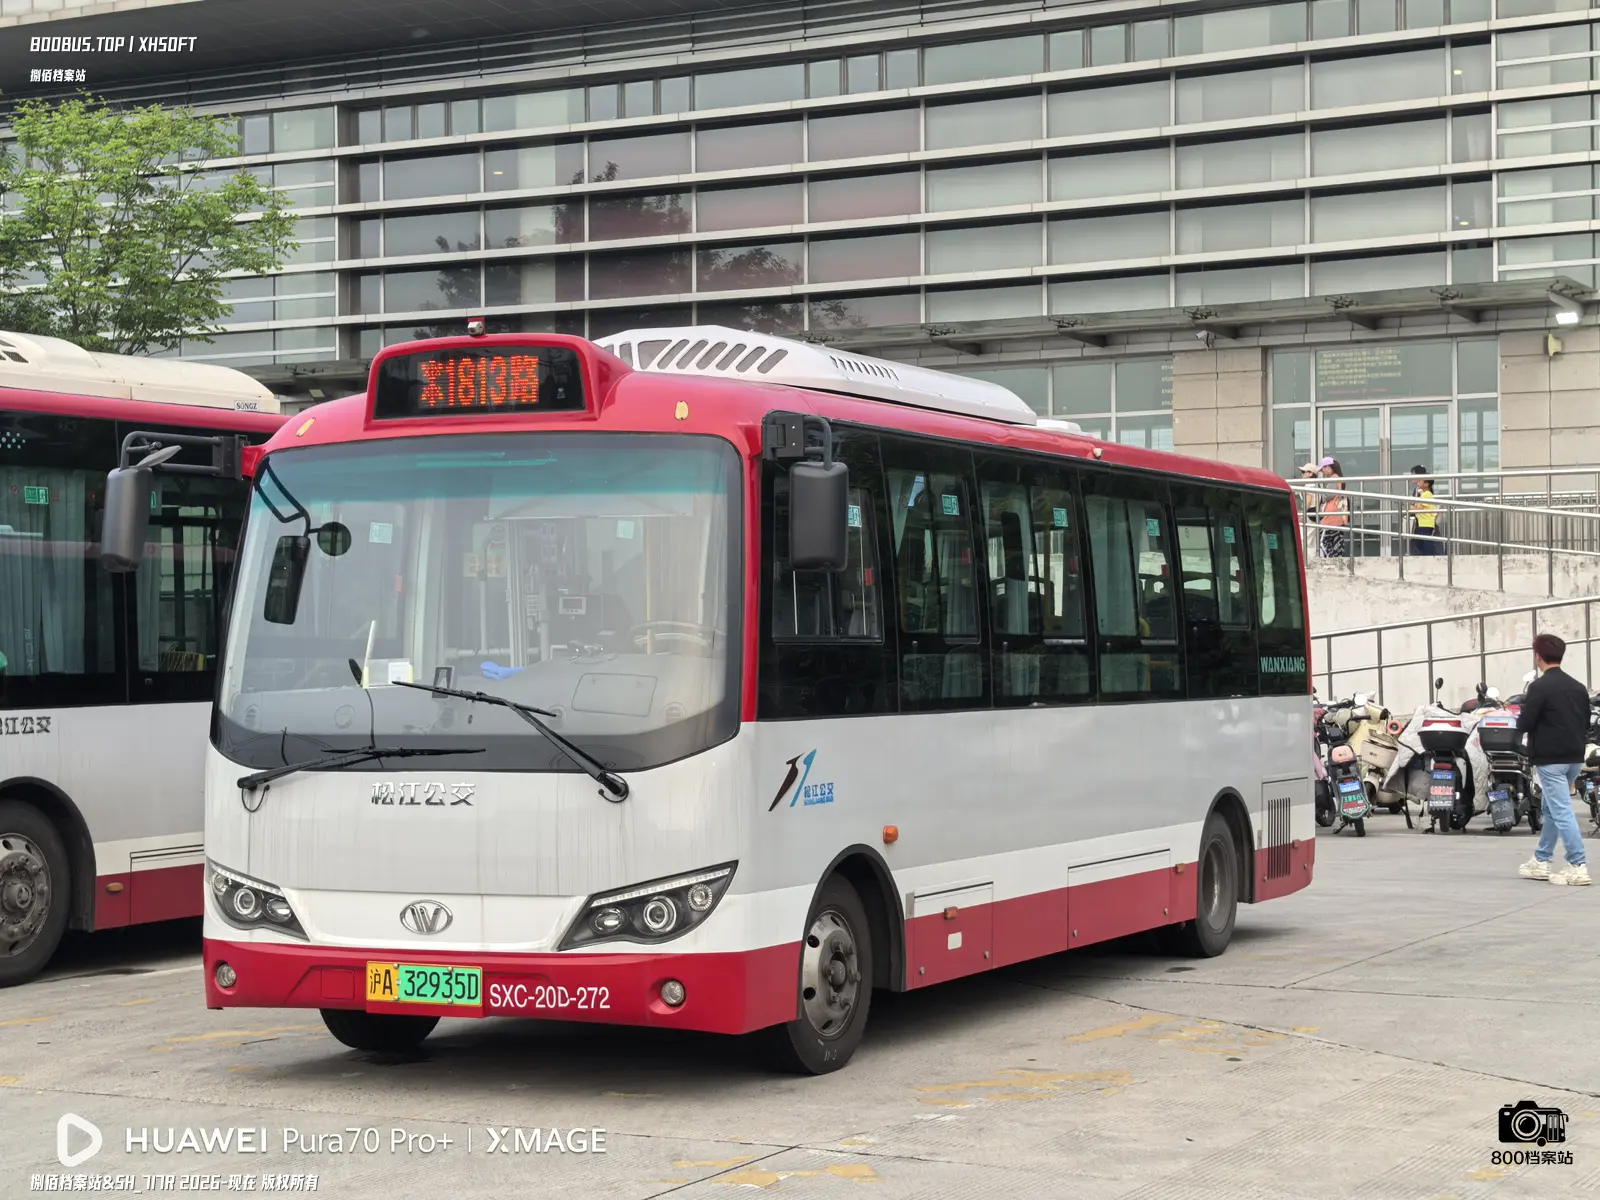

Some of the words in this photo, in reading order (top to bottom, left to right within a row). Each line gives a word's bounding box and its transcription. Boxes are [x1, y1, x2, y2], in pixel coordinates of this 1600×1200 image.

[236, 402, 258, 410] SONGZ
[1260, 656, 1306, 674] WANXIANG
[0, 717, 51, 735] 江公交
[371, 781, 476, 806] 松江公交
[804, 783, 834, 798] 松江公交
[489, 983, 610, 1010] SXC-20D-272
